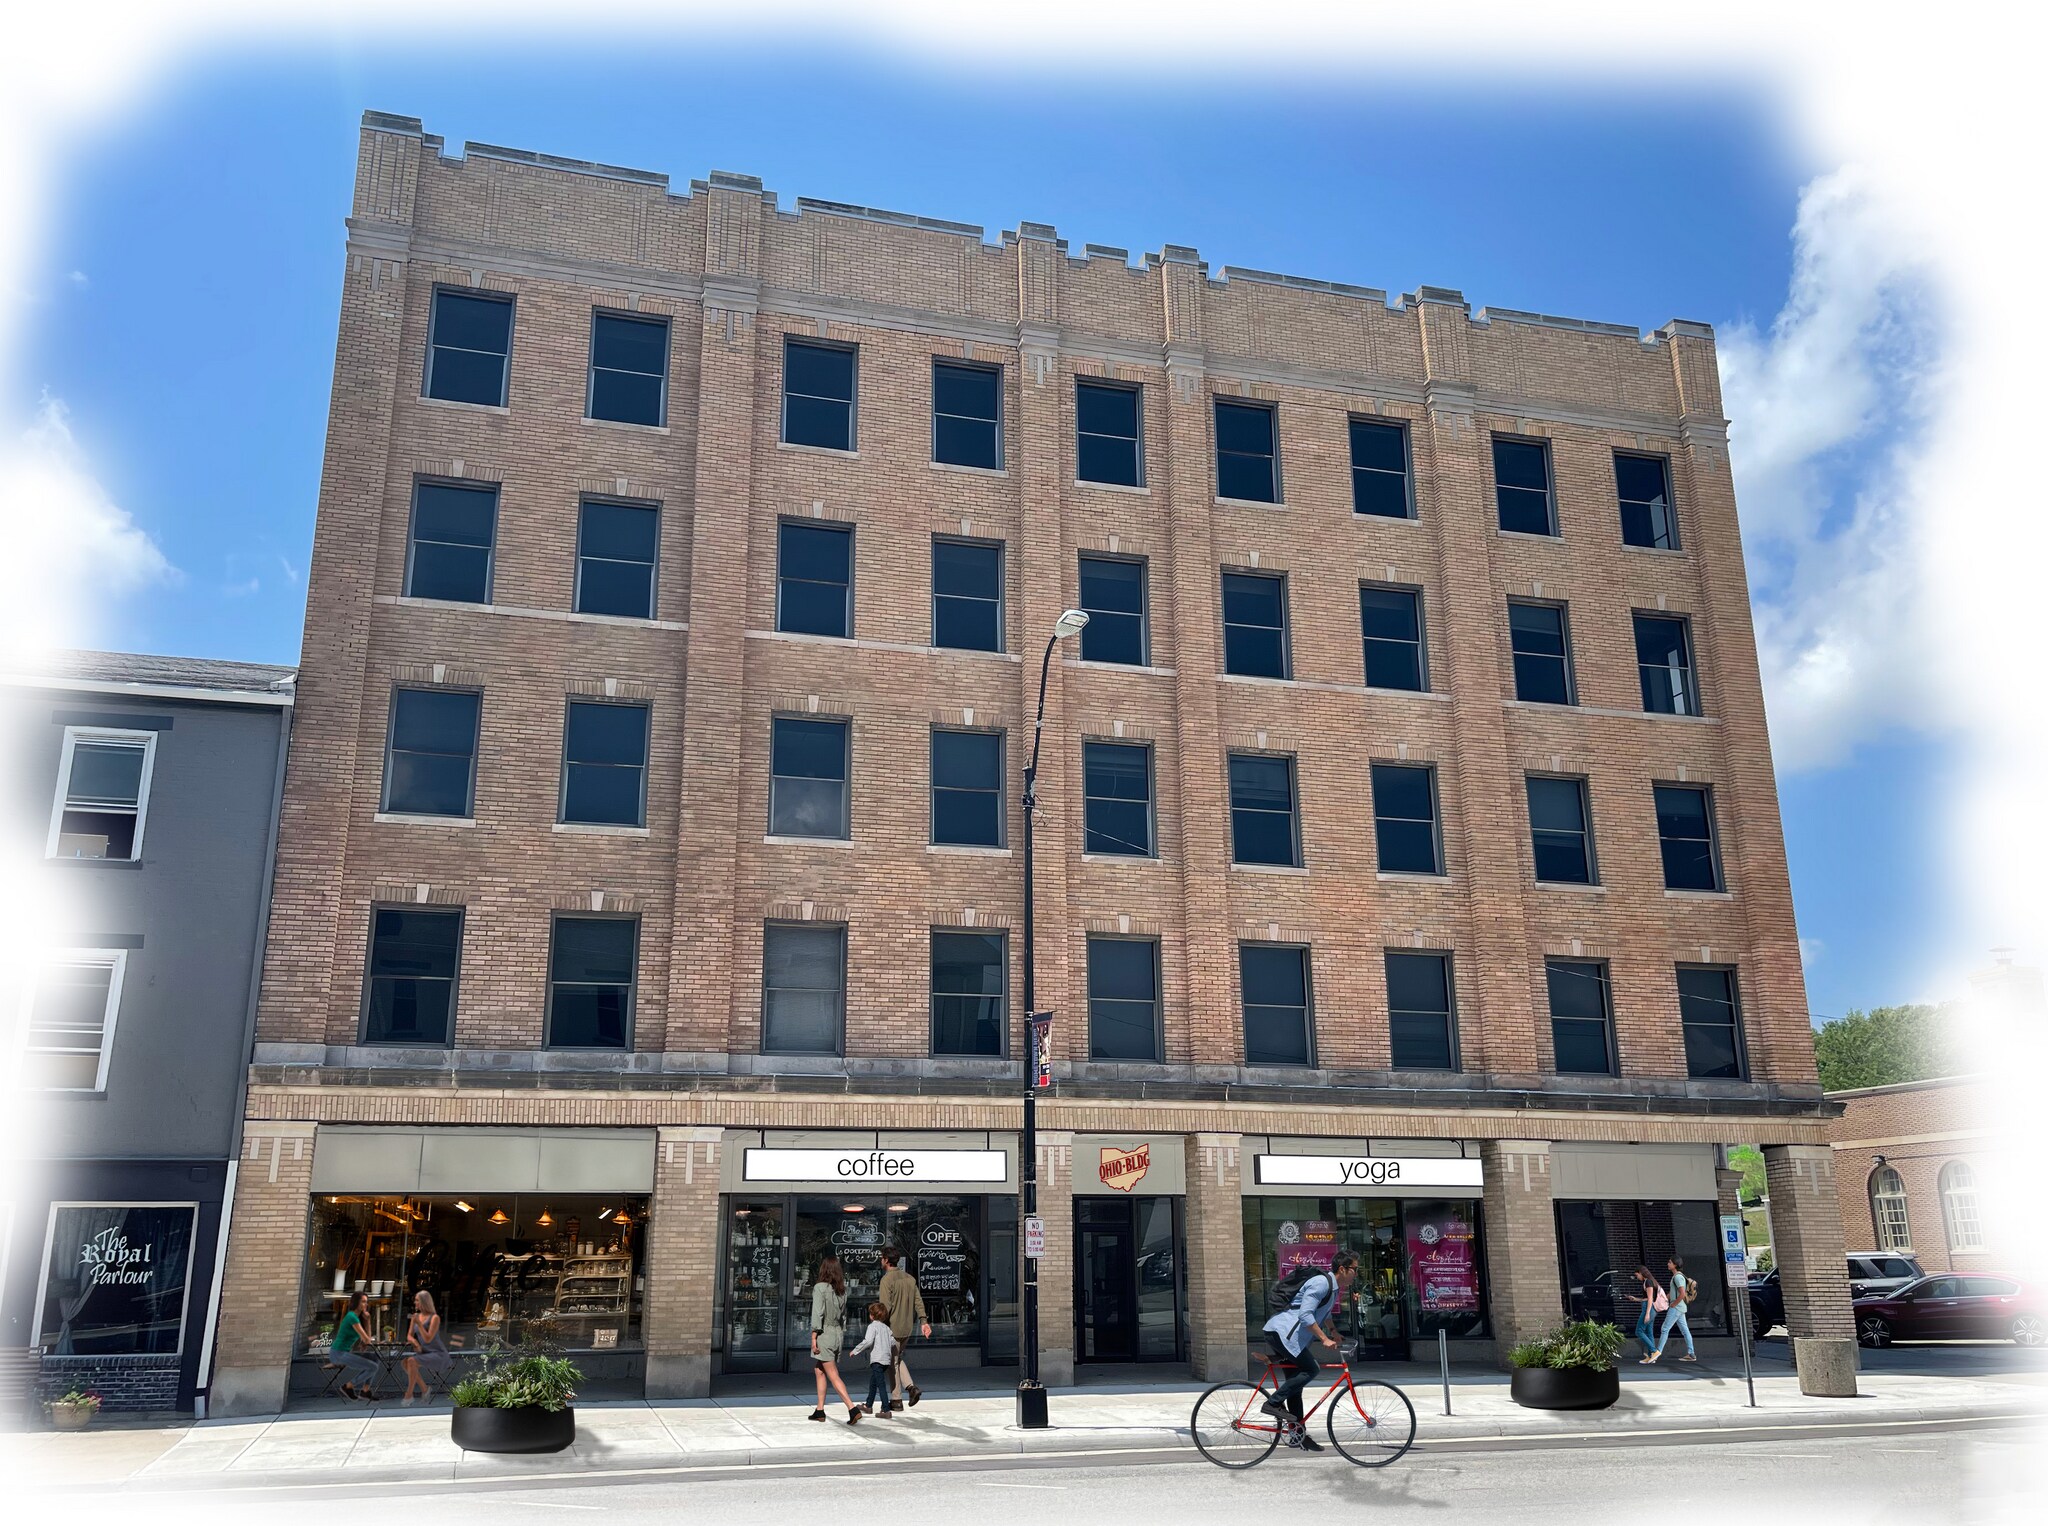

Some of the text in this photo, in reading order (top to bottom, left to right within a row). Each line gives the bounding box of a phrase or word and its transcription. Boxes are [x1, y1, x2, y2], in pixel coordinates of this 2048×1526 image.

[837, 1152, 915, 1176] coffee
[1339, 1161, 1400, 1184] yoga
[94, 1226, 119, 1251] The
[79, 1243, 152, 1267] Royal
[90, 1260, 154, 1285] Parlour
[488, 1293, 525, 1301] HOUSE
